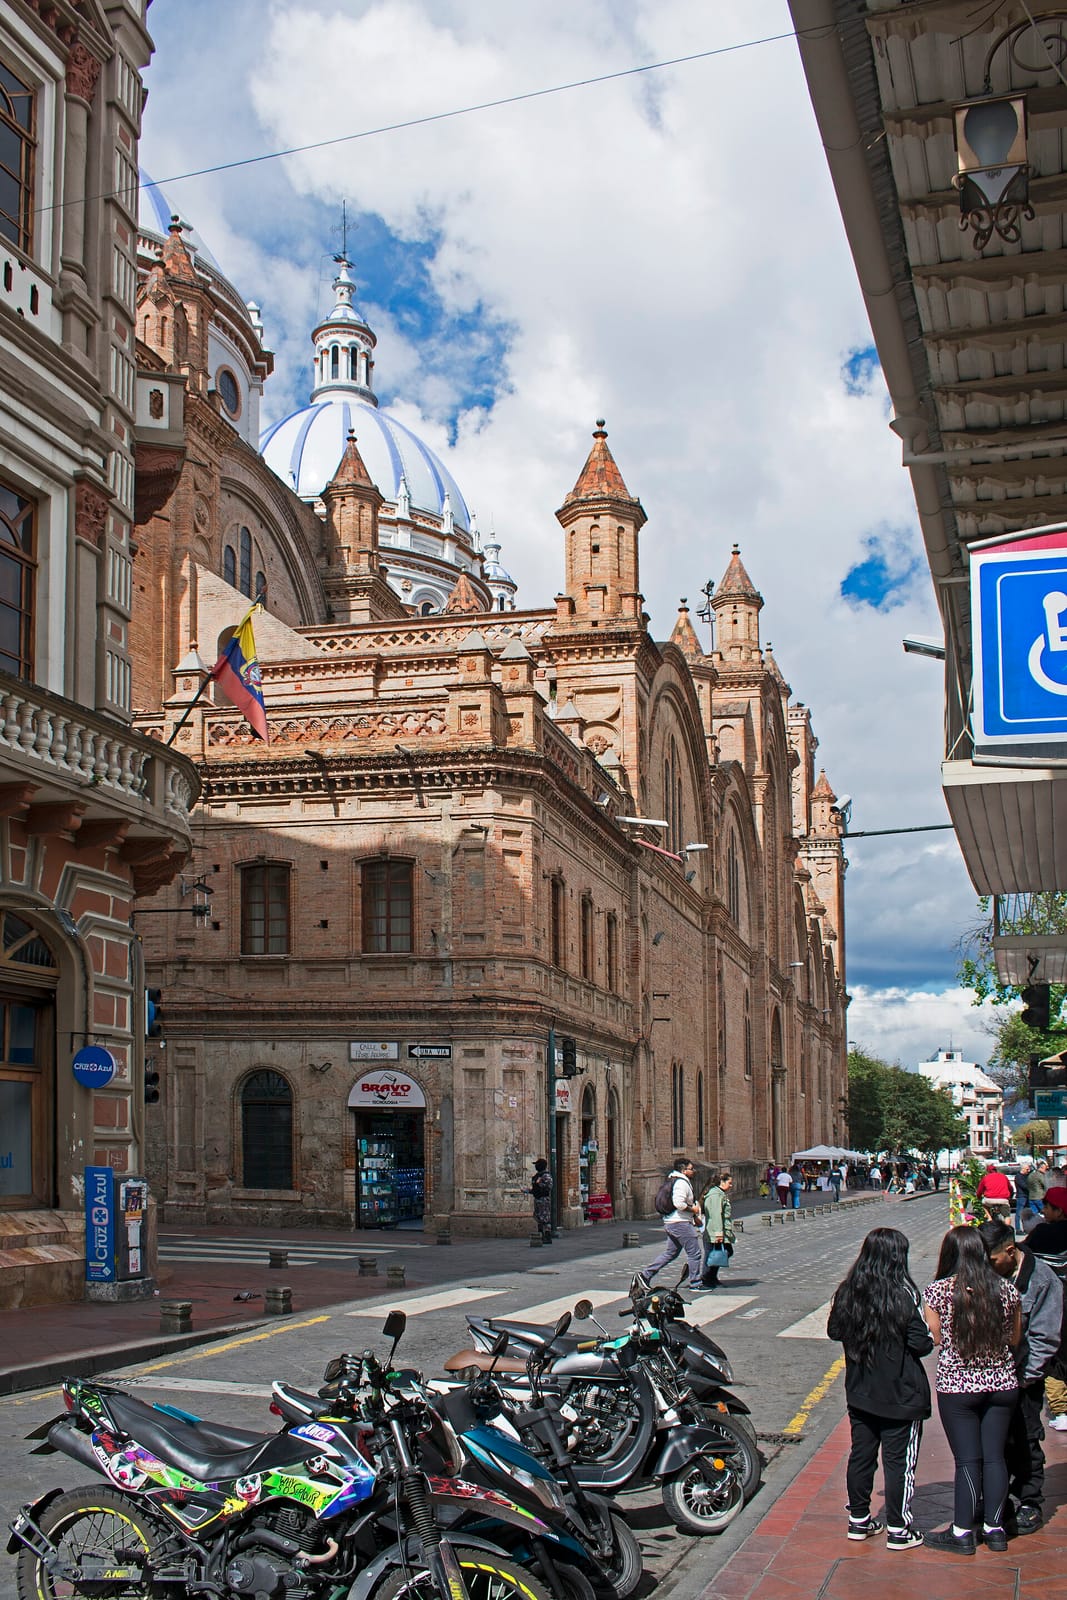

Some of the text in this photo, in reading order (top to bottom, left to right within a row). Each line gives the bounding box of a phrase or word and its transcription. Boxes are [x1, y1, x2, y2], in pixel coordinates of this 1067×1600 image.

[73, 1062, 112, 1072] Cruz Azul
[361, 1083, 411, 1093] BRAVO
[93, 1173, 107, 1206] Azul
[95, 1226, 109, 1260] Cruz
[298, 1423, 336, 1442] JOKER
